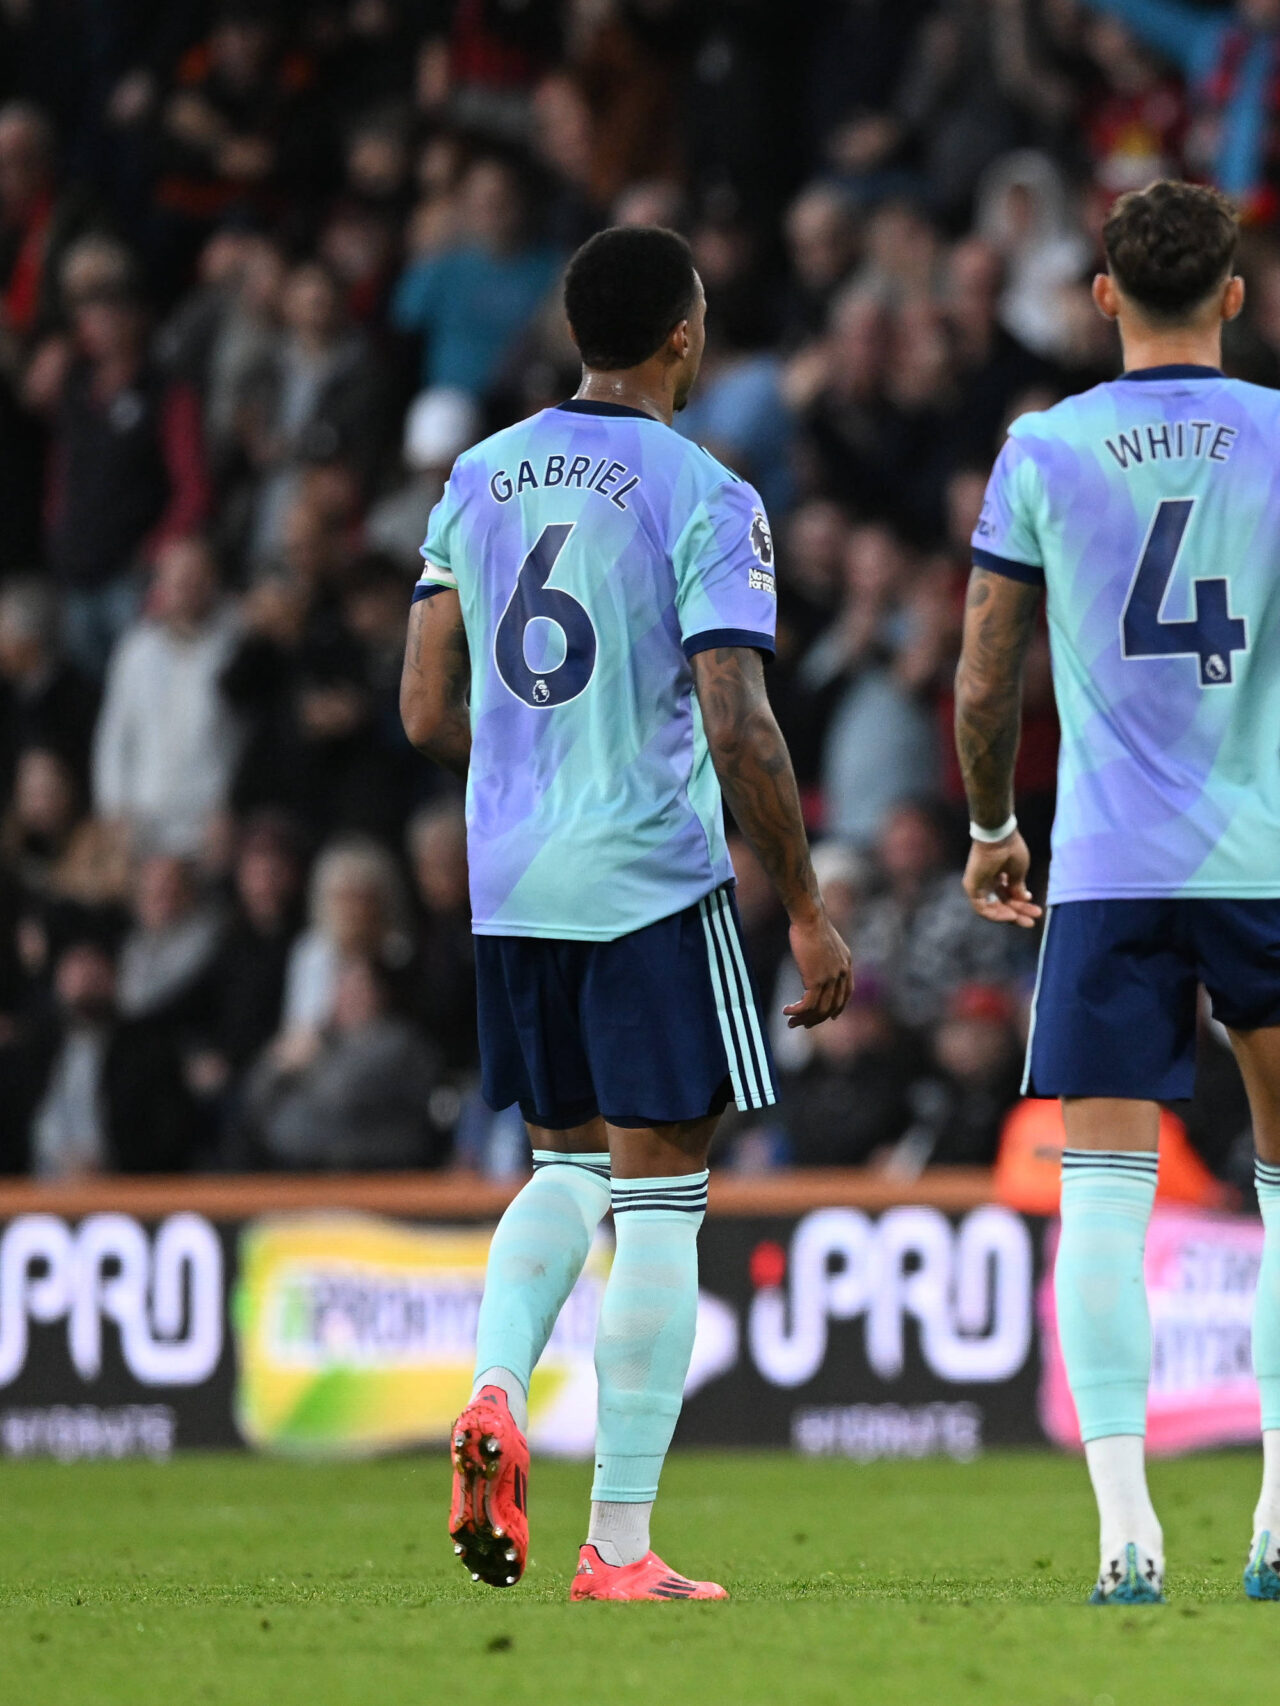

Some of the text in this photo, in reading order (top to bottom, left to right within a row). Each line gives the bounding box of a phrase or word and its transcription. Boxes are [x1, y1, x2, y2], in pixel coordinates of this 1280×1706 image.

[490, 453, 641, 512] GABRIEL
[1103, 420, 1237, 470] WHITE
[494, 521, 599, 709] 6
[1119, 496, 1250, 688] 4
[0, 1211, 224, 1388] PRO
[750, 1204, 1033, 1388] iPRO
